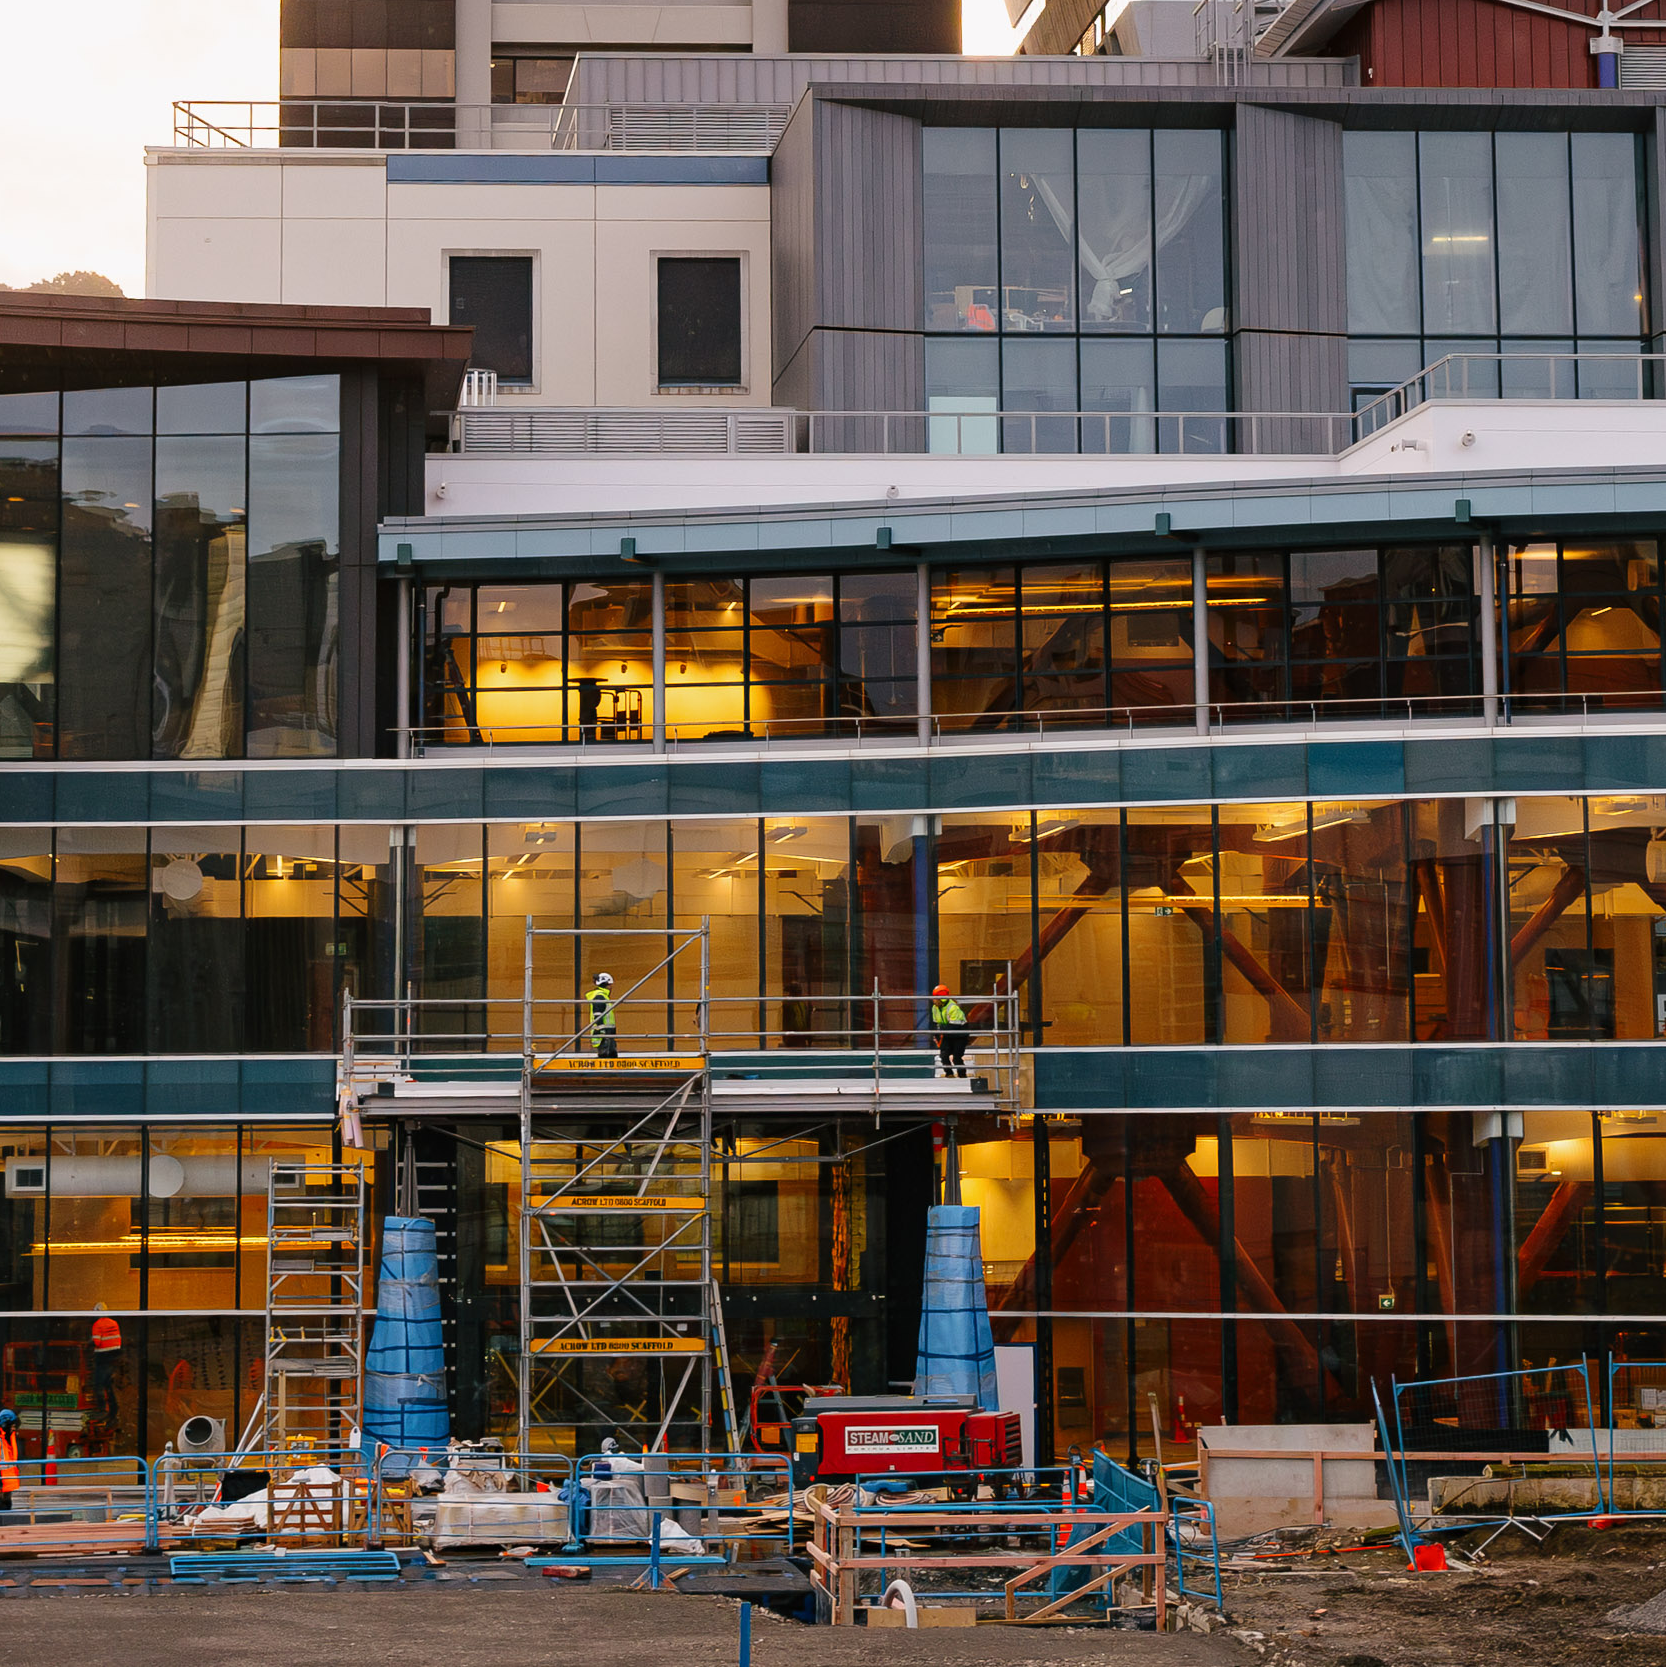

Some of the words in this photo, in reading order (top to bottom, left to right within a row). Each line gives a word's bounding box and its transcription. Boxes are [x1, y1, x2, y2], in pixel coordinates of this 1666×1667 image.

[638, 1060, 681, 1069] SCAFFOLD
[571, 1197, 599, 1206] ACROW
[599, 1197, 614, 1206] LTD
[634, 1198, 667, 1207] SCAFFOLD
[591, 1342, 608, 1351] LTD
[631, 1341, 674, 1350] SCAFFOLD
[850, 1432, 889, 1444] STEAM
[897, 1431, 935, 1444] SAND
